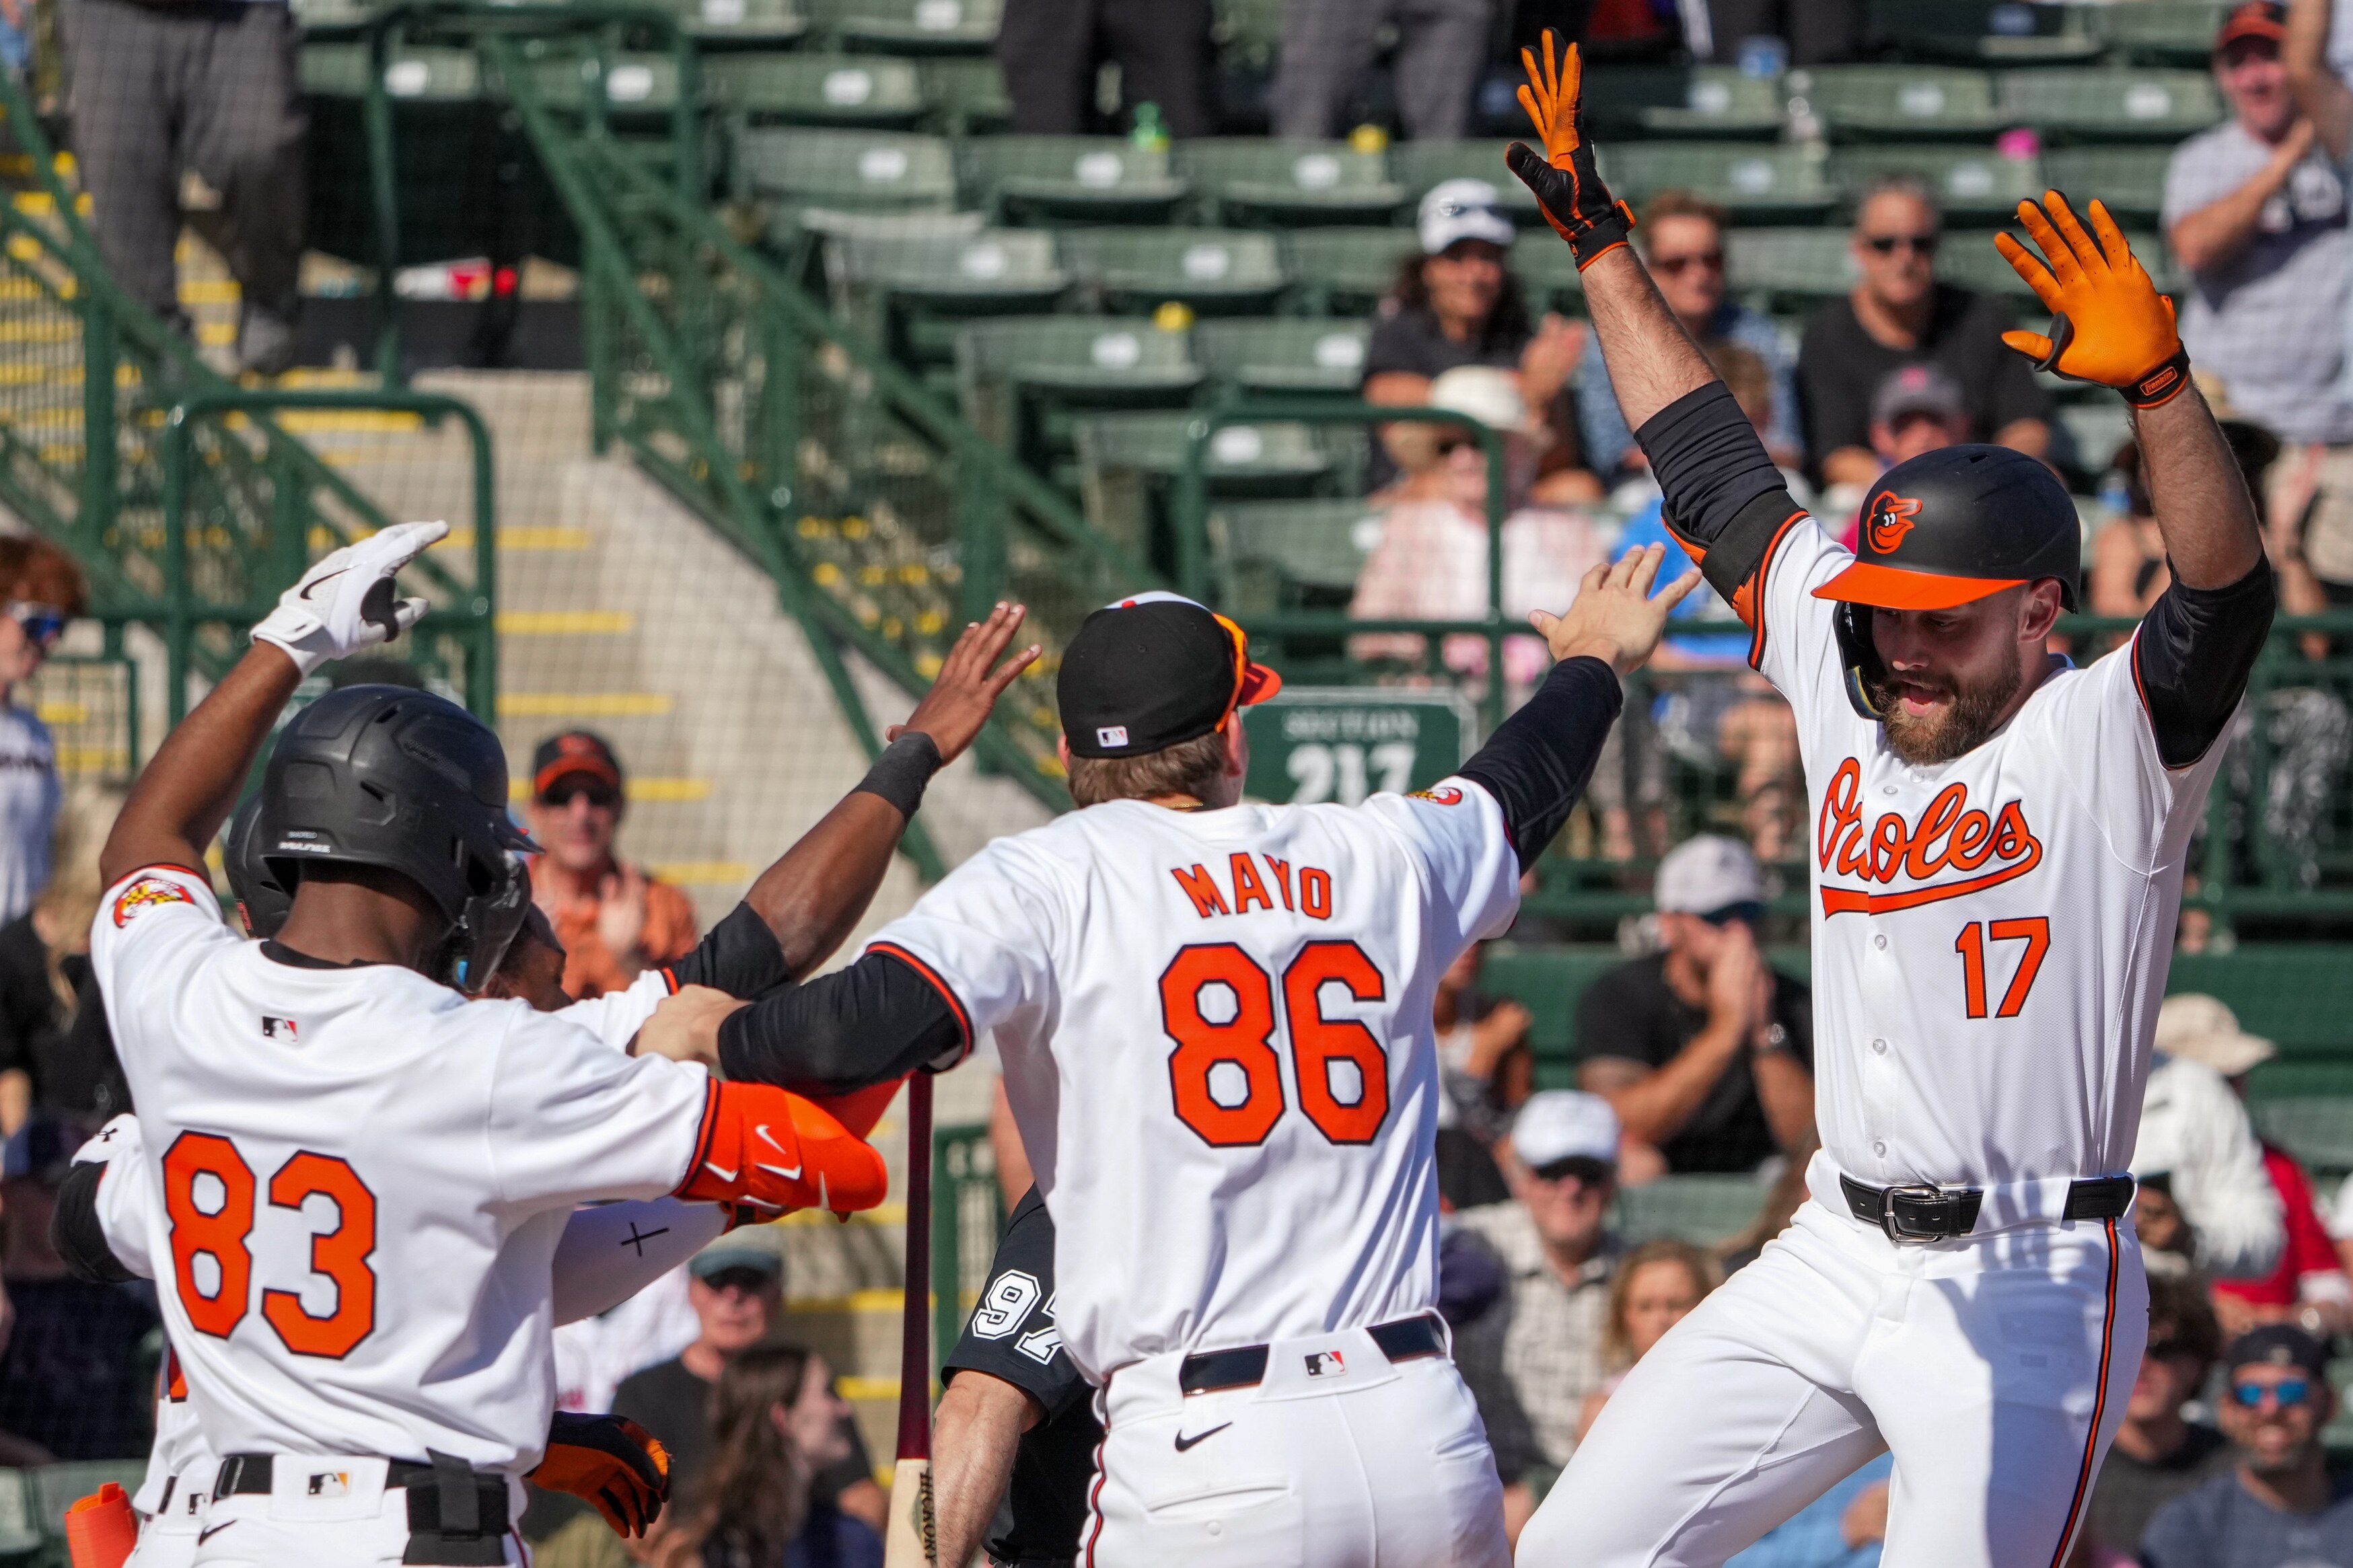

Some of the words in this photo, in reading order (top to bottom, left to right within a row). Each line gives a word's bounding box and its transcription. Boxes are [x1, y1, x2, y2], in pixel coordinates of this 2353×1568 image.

[2145, 371, 2174, 394] Franklin
[1286, 743, 1416, 805] 217
[1171, 852, 1332, 920] MAYO
[1955, 916, 2051, 1019] 17
[1158, 939, 1389, 1148] 86
[161, 1129, 377, 1361] 83
